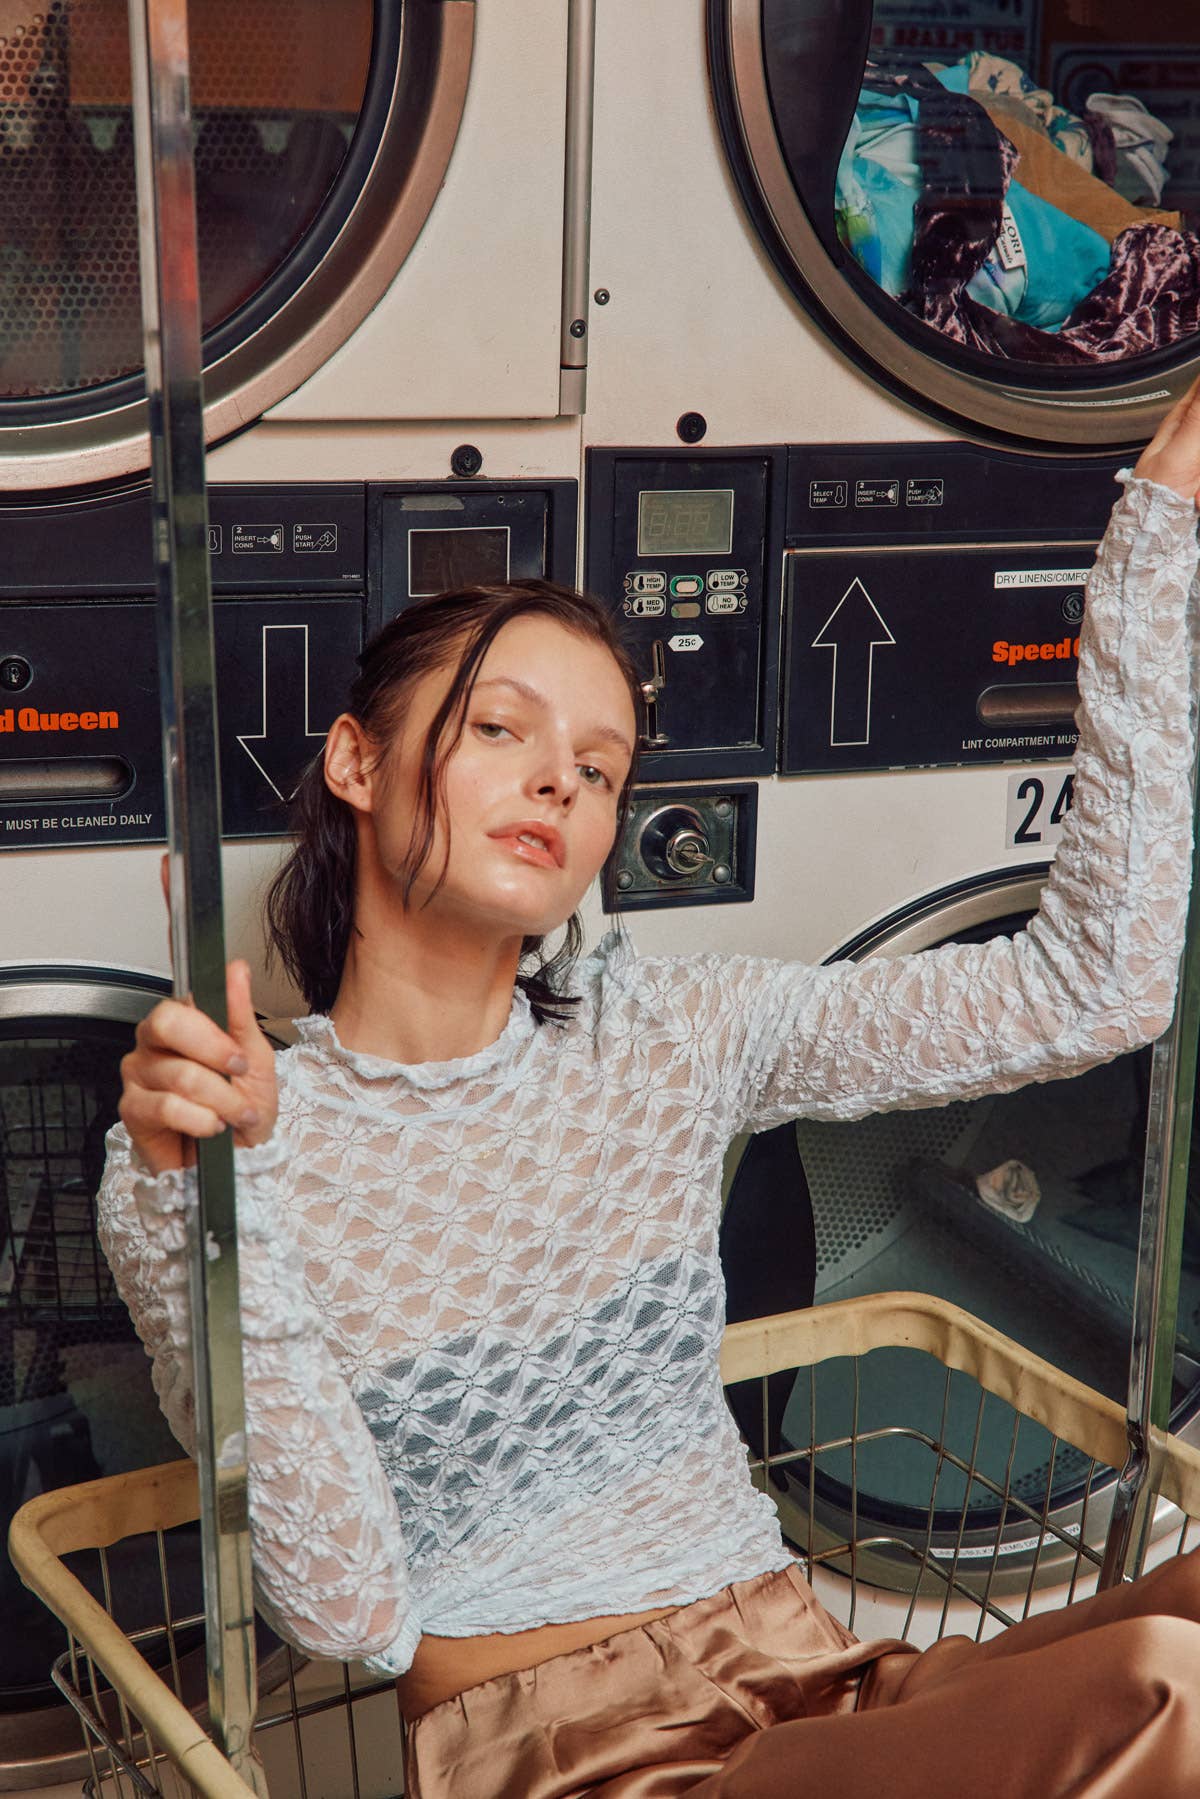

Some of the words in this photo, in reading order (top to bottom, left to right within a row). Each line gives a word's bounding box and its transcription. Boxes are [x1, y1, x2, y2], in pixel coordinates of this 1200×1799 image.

[1003, 216, 1022, 254] LORI
[236, 526, 243, 534] 2
[296, 525, 302, 533] 3
[996, 575, 1017, 585] DRY
[992, 637, 1072, 666] Speed
[18, 707, 119, 732] Queen
[962, 739, 983, 750] LINT
[985, 736, 1055, 748] COMPARTMENT
[6, 819, 39, 831] MUST
[42, 818, 58, 829] BE
[61, 815, 117, 828] CLEANED
[120, 814, 152, 825] DAILY
